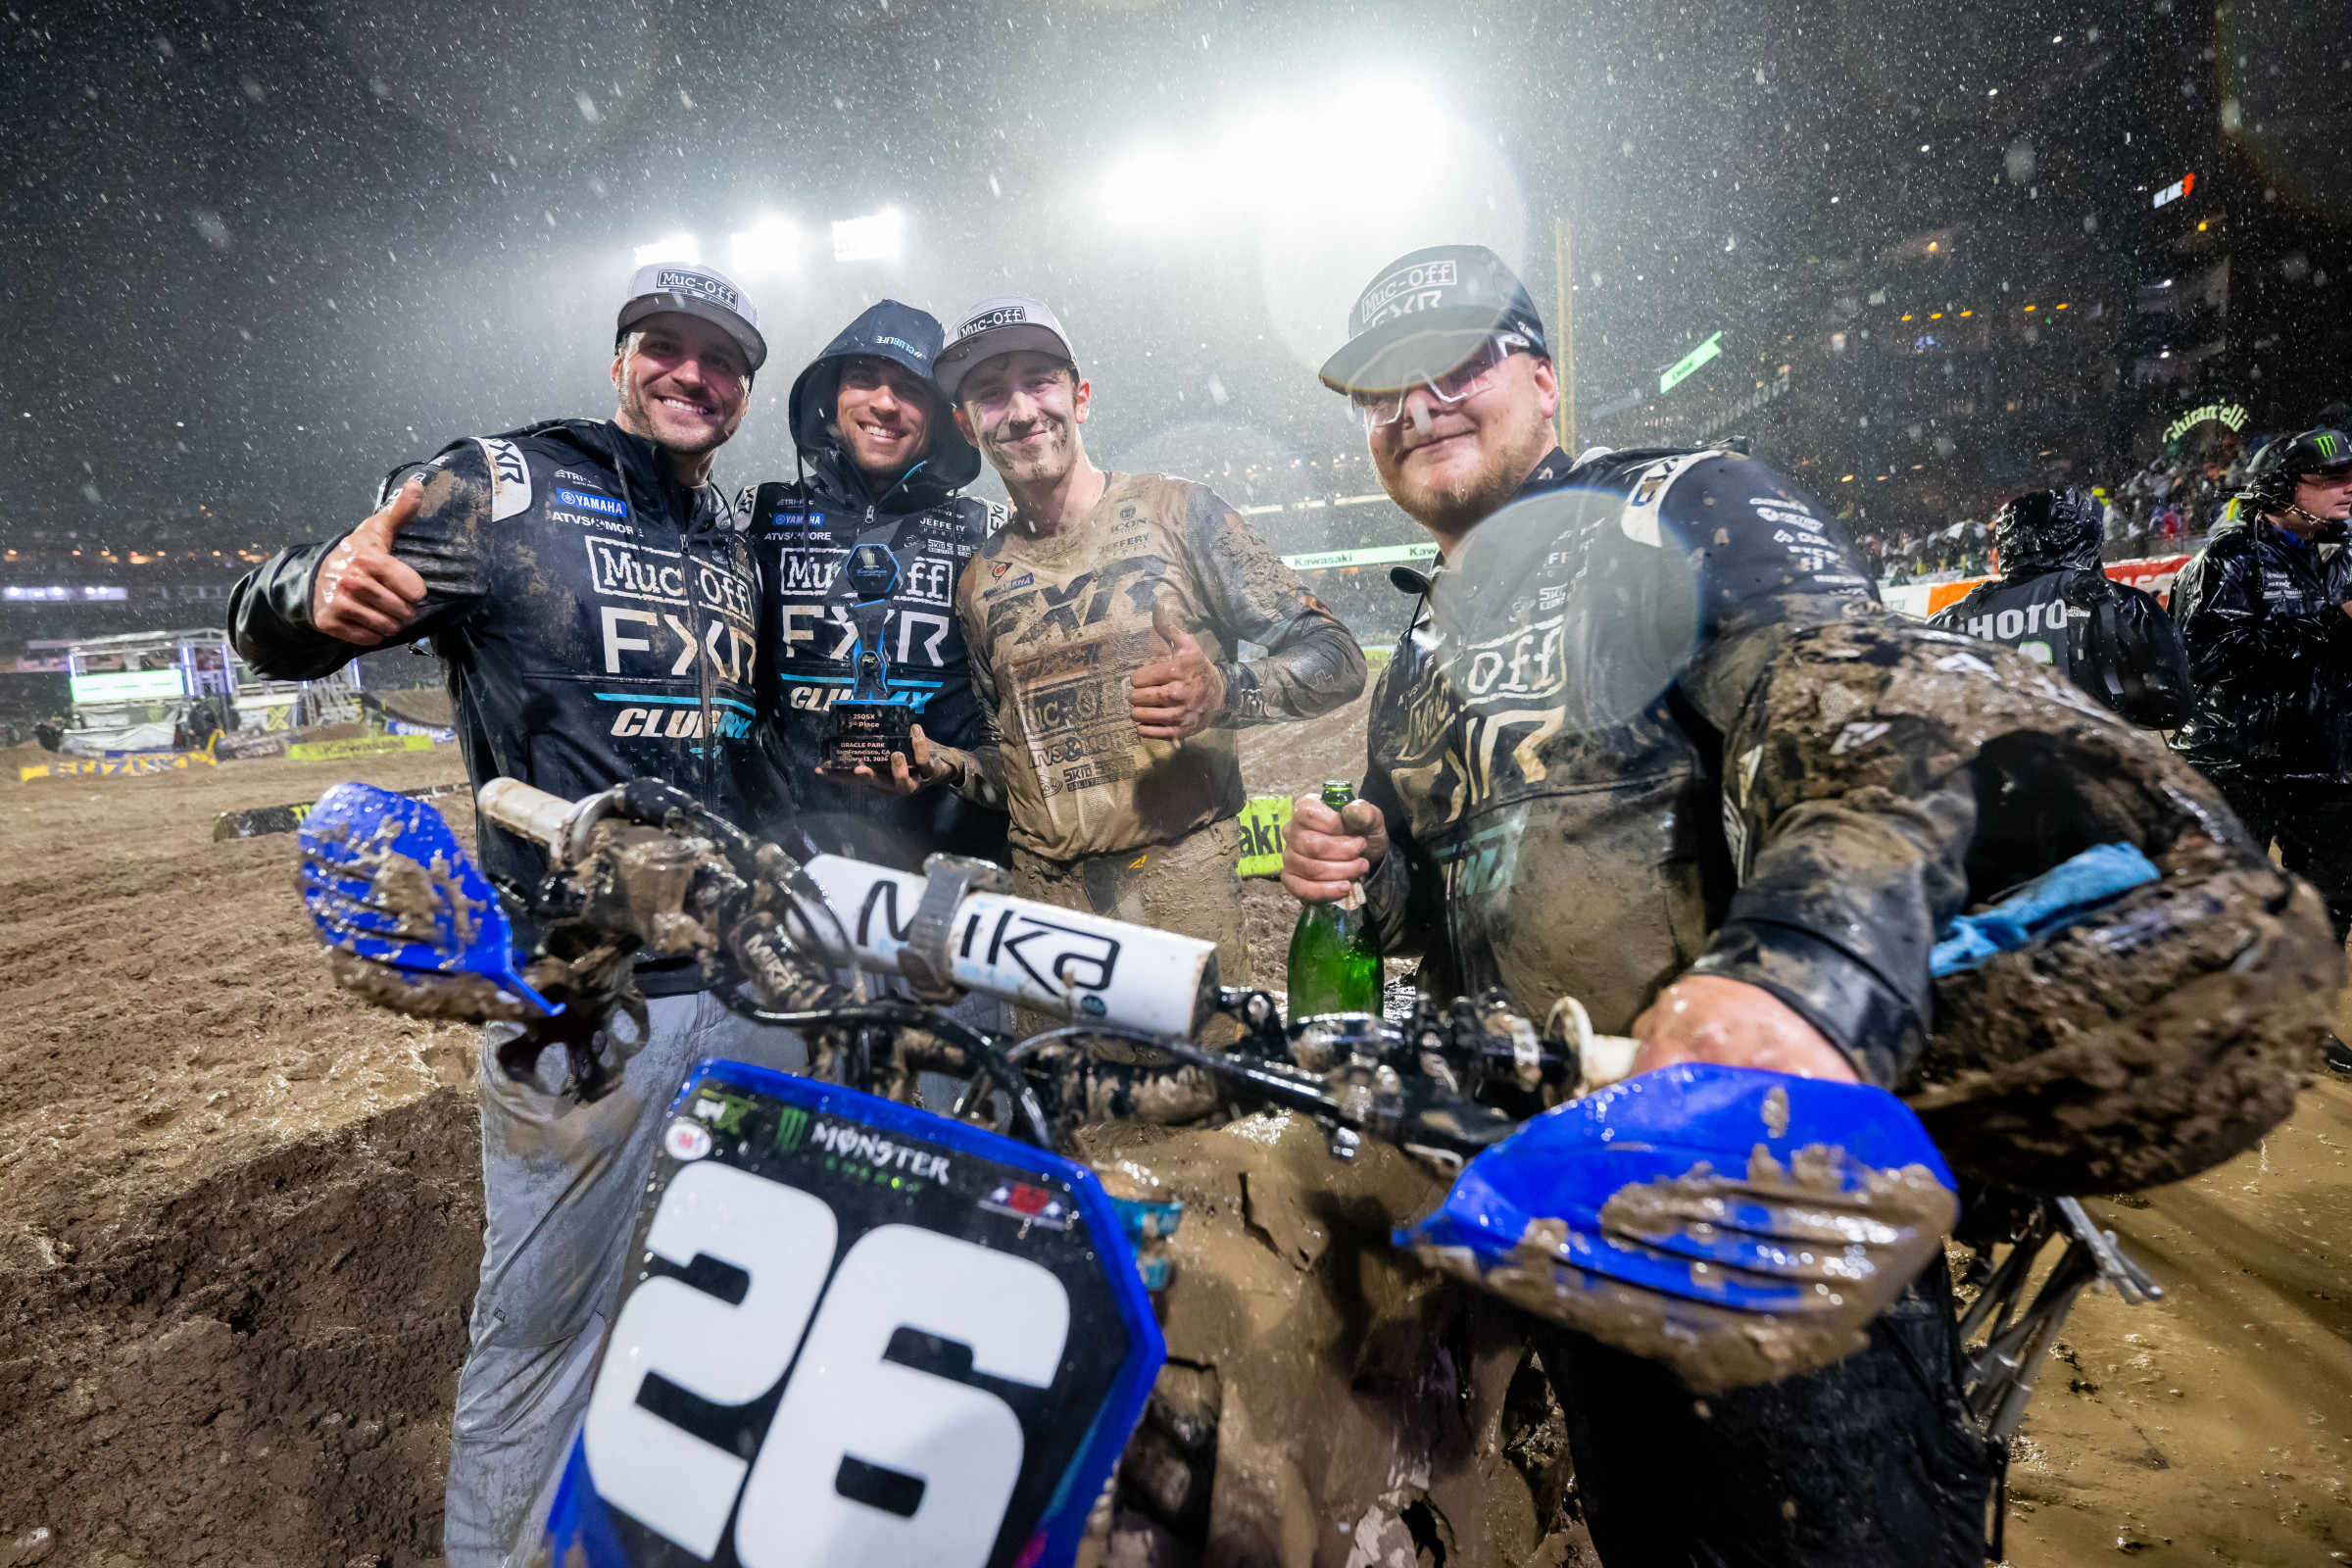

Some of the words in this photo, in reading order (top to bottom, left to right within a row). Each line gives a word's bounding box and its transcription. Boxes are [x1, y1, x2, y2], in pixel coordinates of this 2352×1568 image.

[662, 273, 735, 305] Muc-Off
[1364, 264, 1451, 318] Muc-Off
[960, 310, 1022, 337] Muc-Off
[877, 335, 922, 359] #CLUBLIFE
[2162, 397, 2248, 443] Ghirarelli
[487, 438, 525, 484] XR
[575, 494, 622, 514] YAMAHA
[786, 515, 820, 524] YAMHA
[1110, 518, 1146, 533] ICON
[1098, 534, 1150, 555] JEFFERY
[1294, 553, 1353, 566] Kawasaki
[1409, 546, 1437, 558] Kaw
[599, 548, 751, 620] Muc-Off
[1968, 599, 2068, 641] HOTO
[1062, 763, 1093, 783] SKID
[1239, 813, 1283, 858] aki
[811, 1121, 951, 1186] MONSTER
[585, 1160, 1070, 1568] 26
